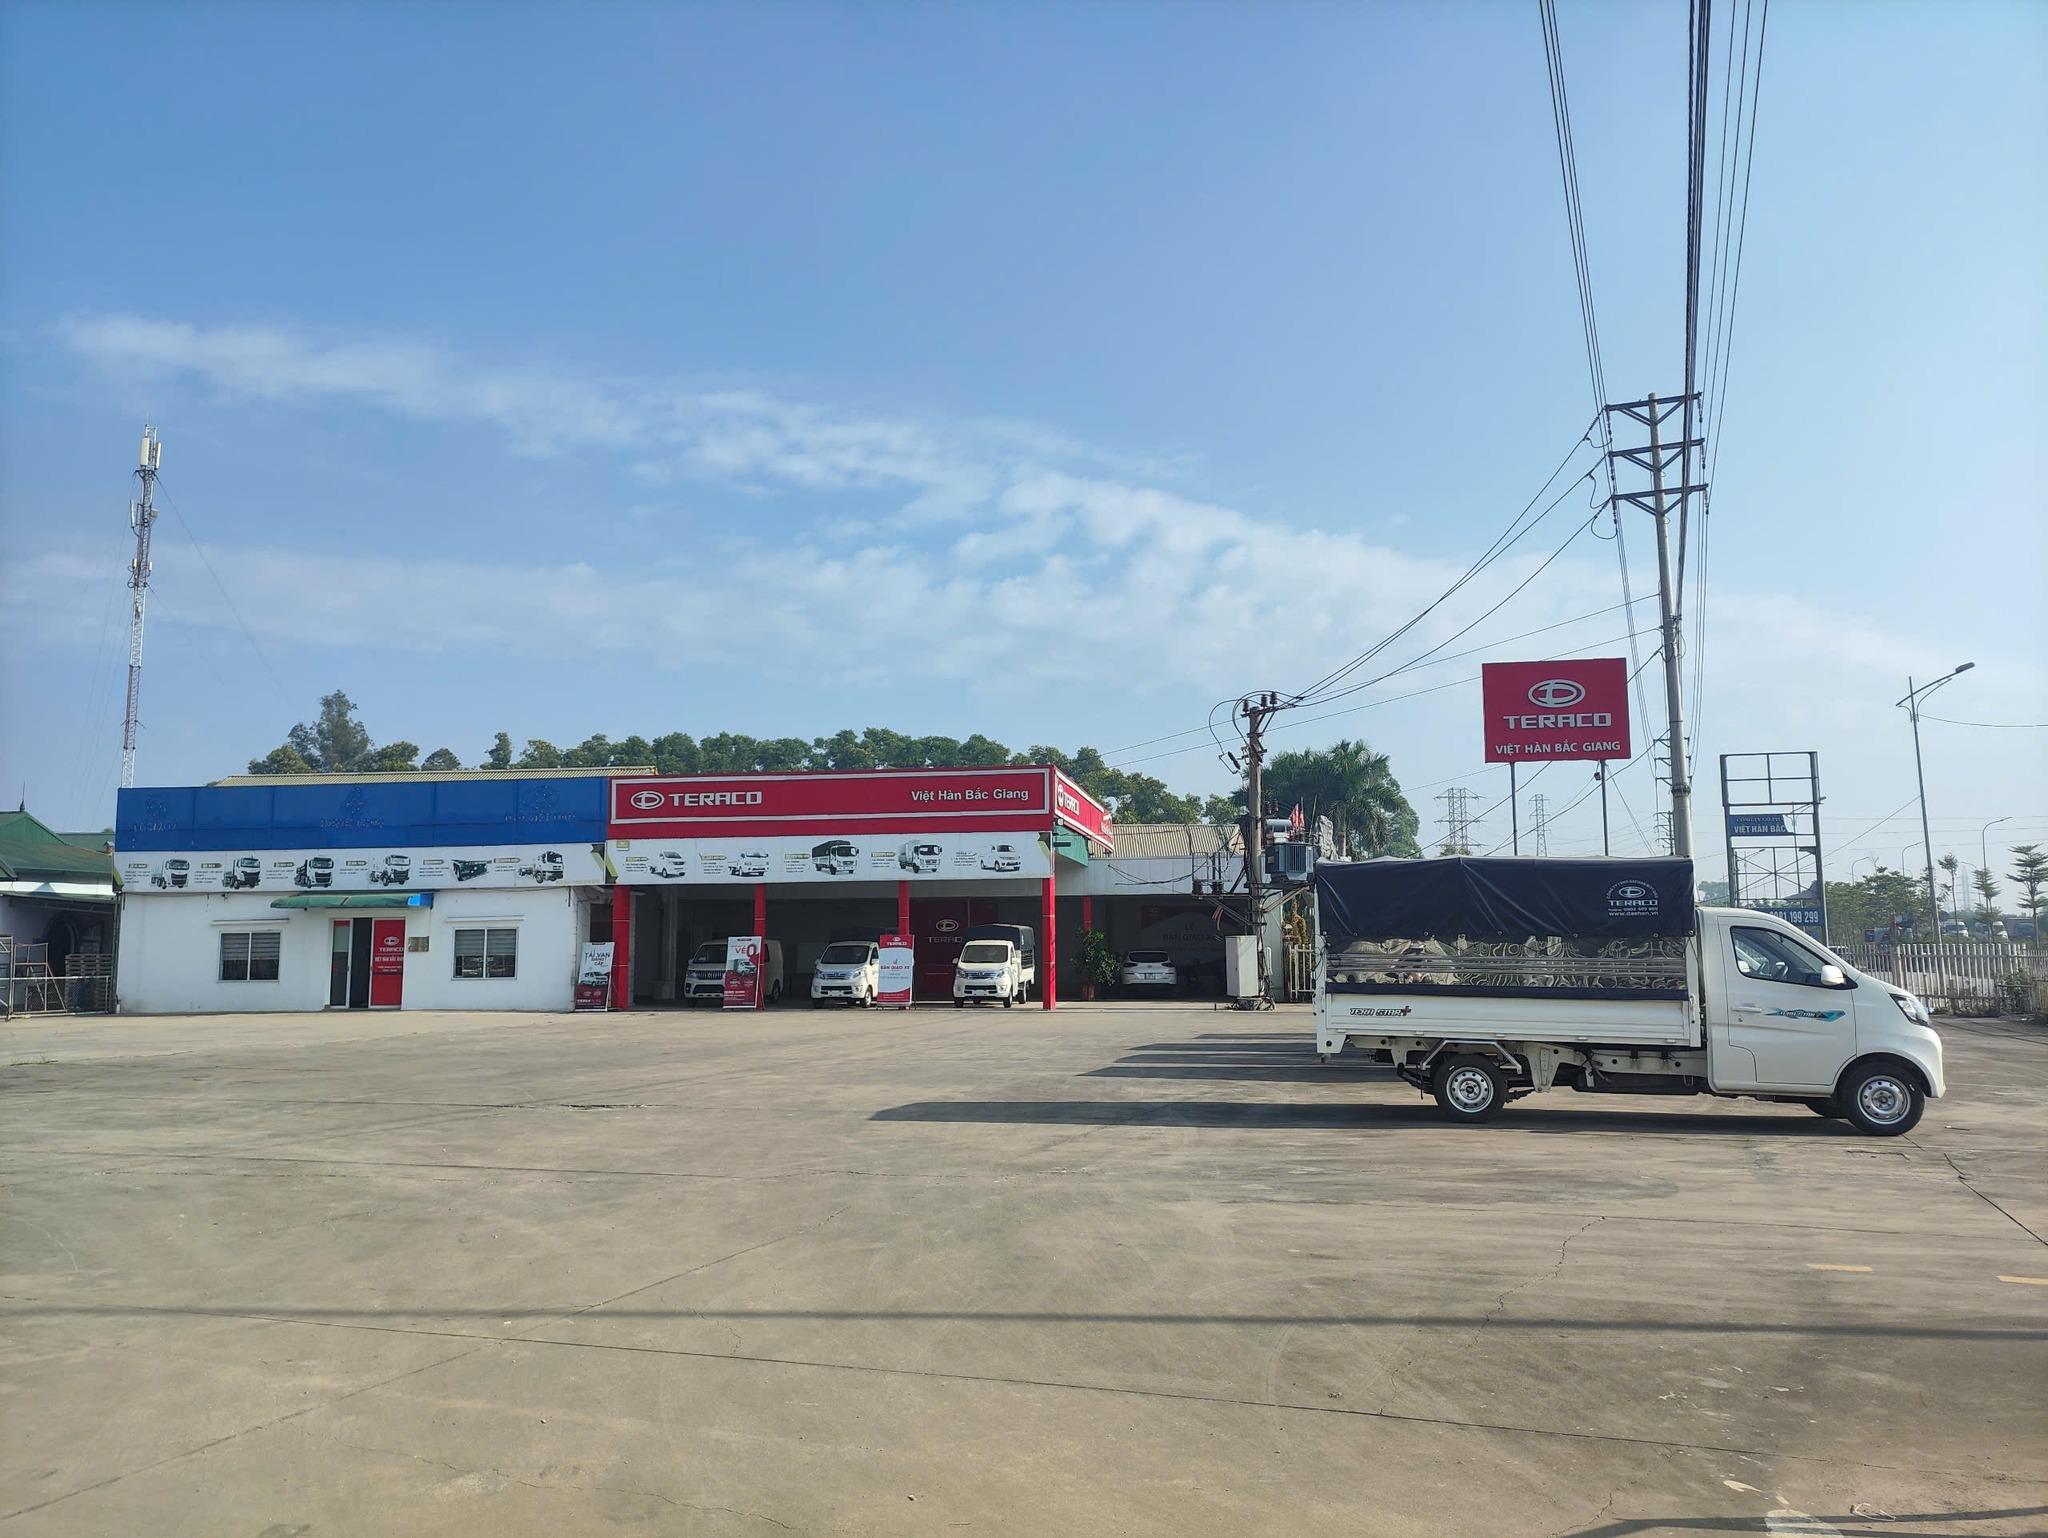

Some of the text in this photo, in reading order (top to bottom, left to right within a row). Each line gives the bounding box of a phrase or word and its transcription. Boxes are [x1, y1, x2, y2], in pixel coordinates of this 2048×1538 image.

[1503, 712, 1612, 729] TERACO
[1495, 738, 1621, 756] VIỆT HÀN BẮC GIANG
[668, 791, 762, 807] TERACO
[911, 786, 1029, 803] Việt Hàn Bắc Giang
[1789, 911, 1802, 923] 199
[1804, 911, 1819, 923] 299
